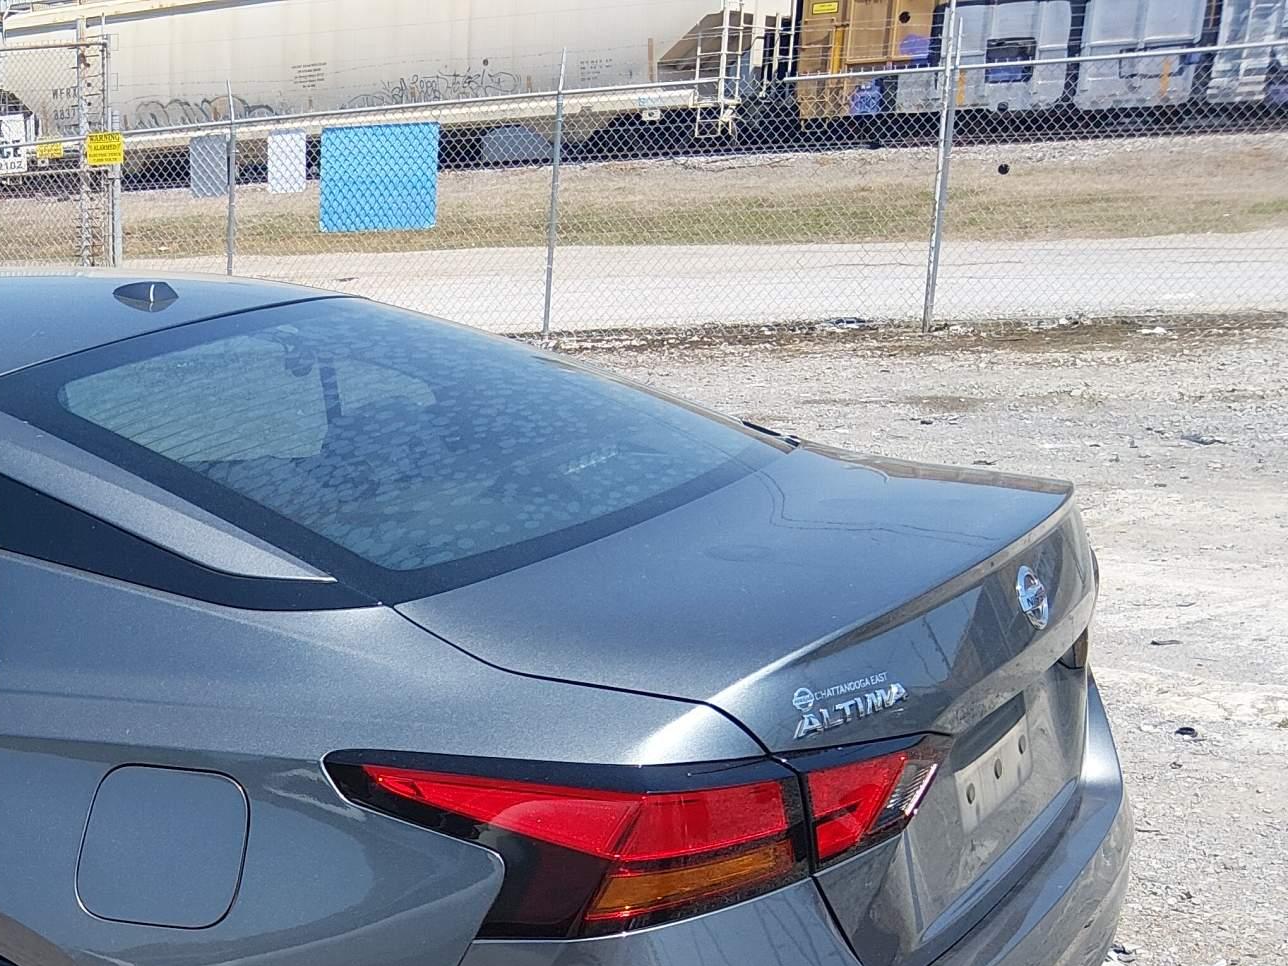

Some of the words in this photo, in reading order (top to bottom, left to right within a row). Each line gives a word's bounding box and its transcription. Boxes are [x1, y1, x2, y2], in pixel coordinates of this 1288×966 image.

[814, 678, 871, 700] CHATTANOOGA
[871, 672, 888, 685] EAST
[793, 683, 910, 739] ALTIMA
